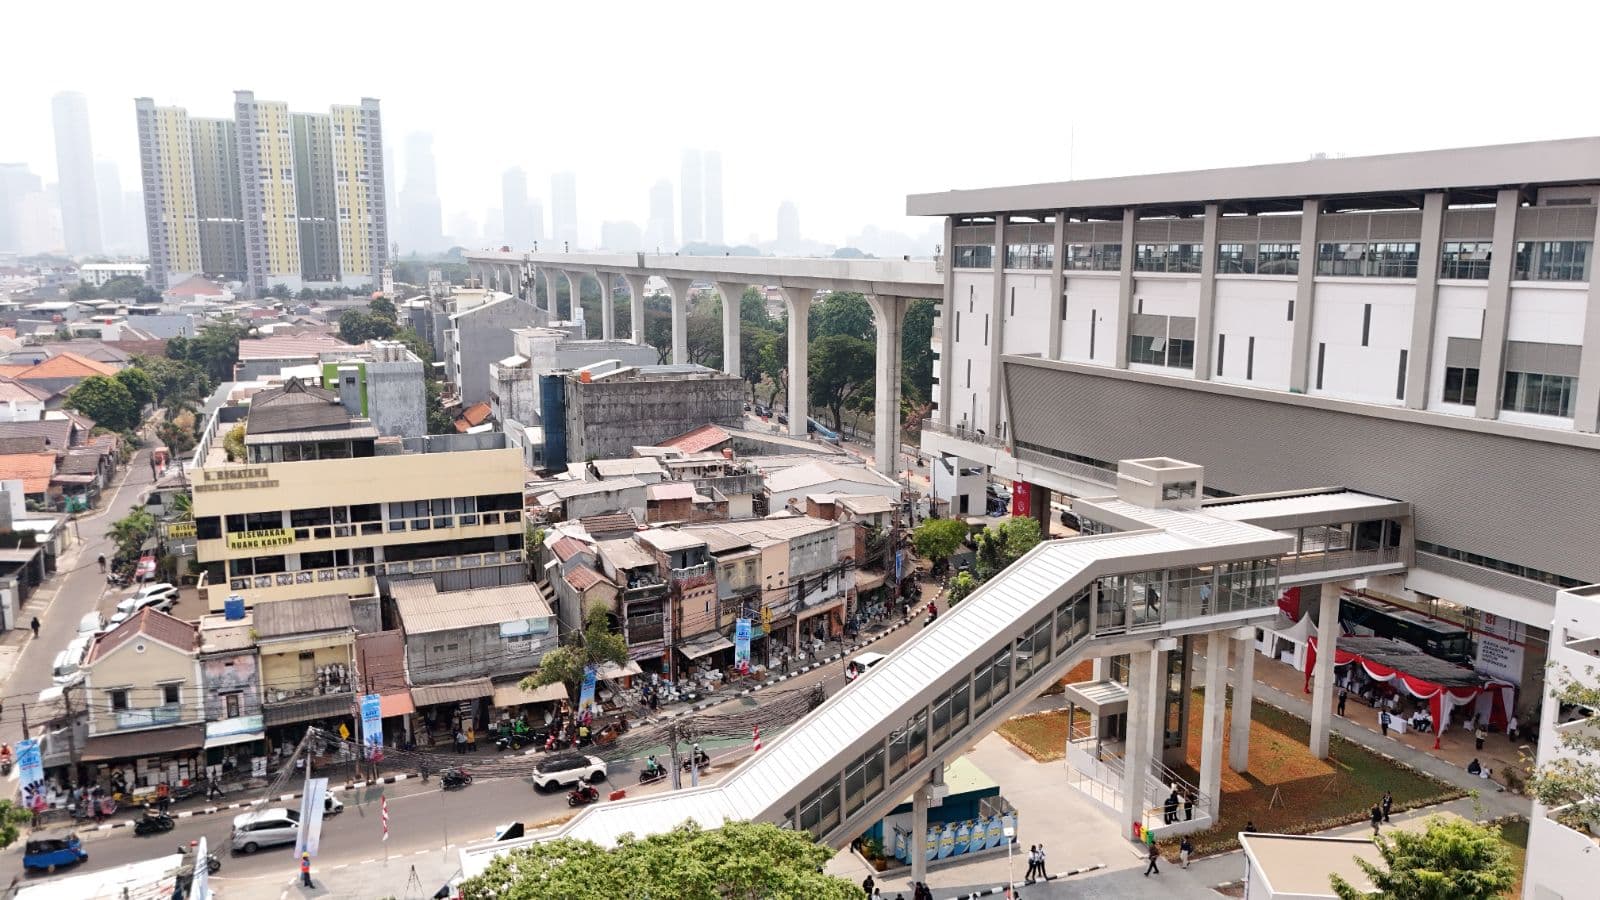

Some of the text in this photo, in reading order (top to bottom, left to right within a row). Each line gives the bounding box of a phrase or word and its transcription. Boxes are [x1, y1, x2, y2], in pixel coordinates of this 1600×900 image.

[237, 529, 286, 539] DISEWAKAN
[231, 537, 293, 549] RUANG KANTOR
